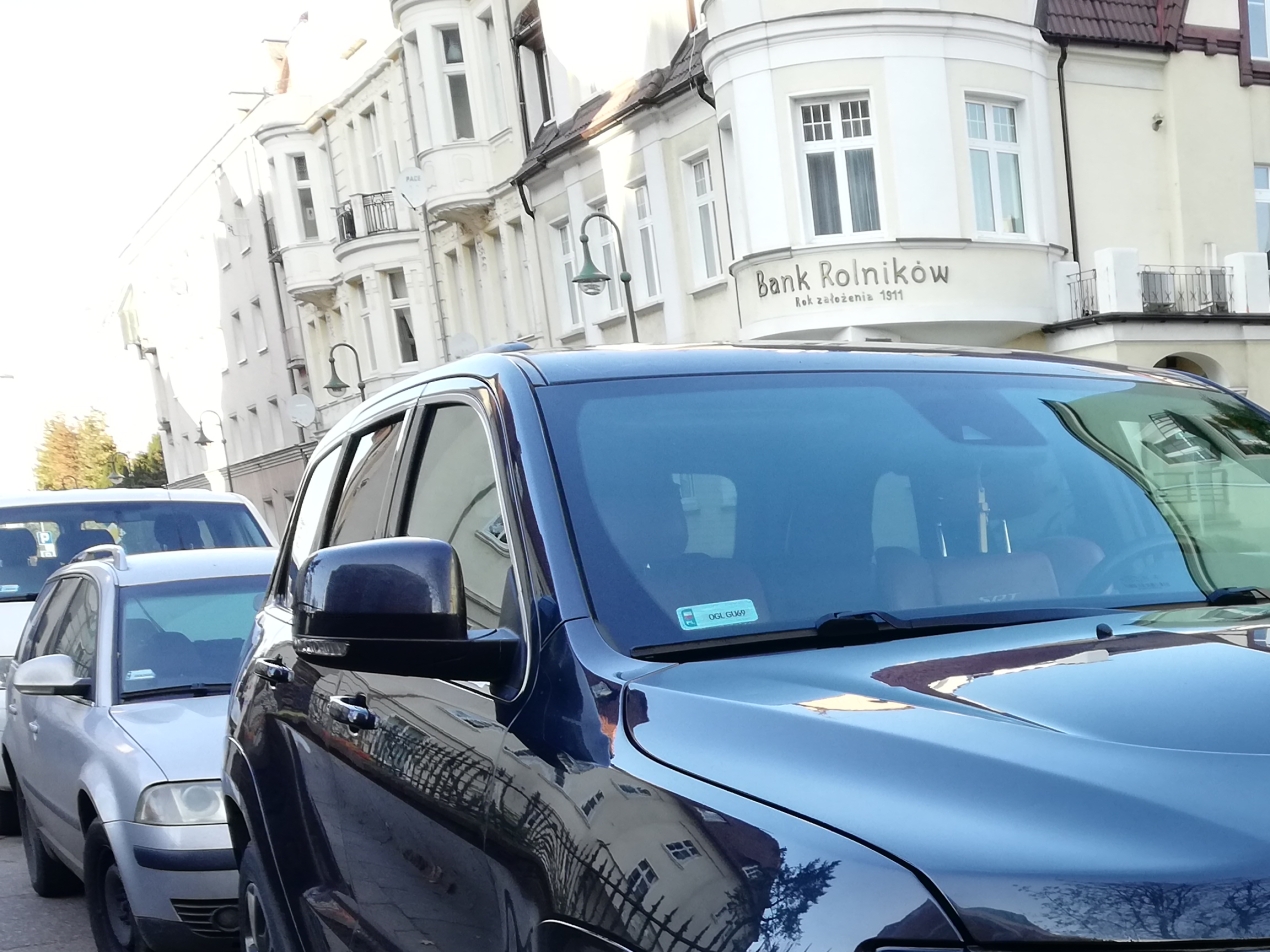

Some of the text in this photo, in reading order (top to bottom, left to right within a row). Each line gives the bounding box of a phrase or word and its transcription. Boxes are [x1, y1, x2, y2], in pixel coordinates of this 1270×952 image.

[757, 257, 949, 298] Bank Rolników
[795, 289, 904, 308] Rok założenia 1911
[709, 609, 746, 621] OGL GU69
